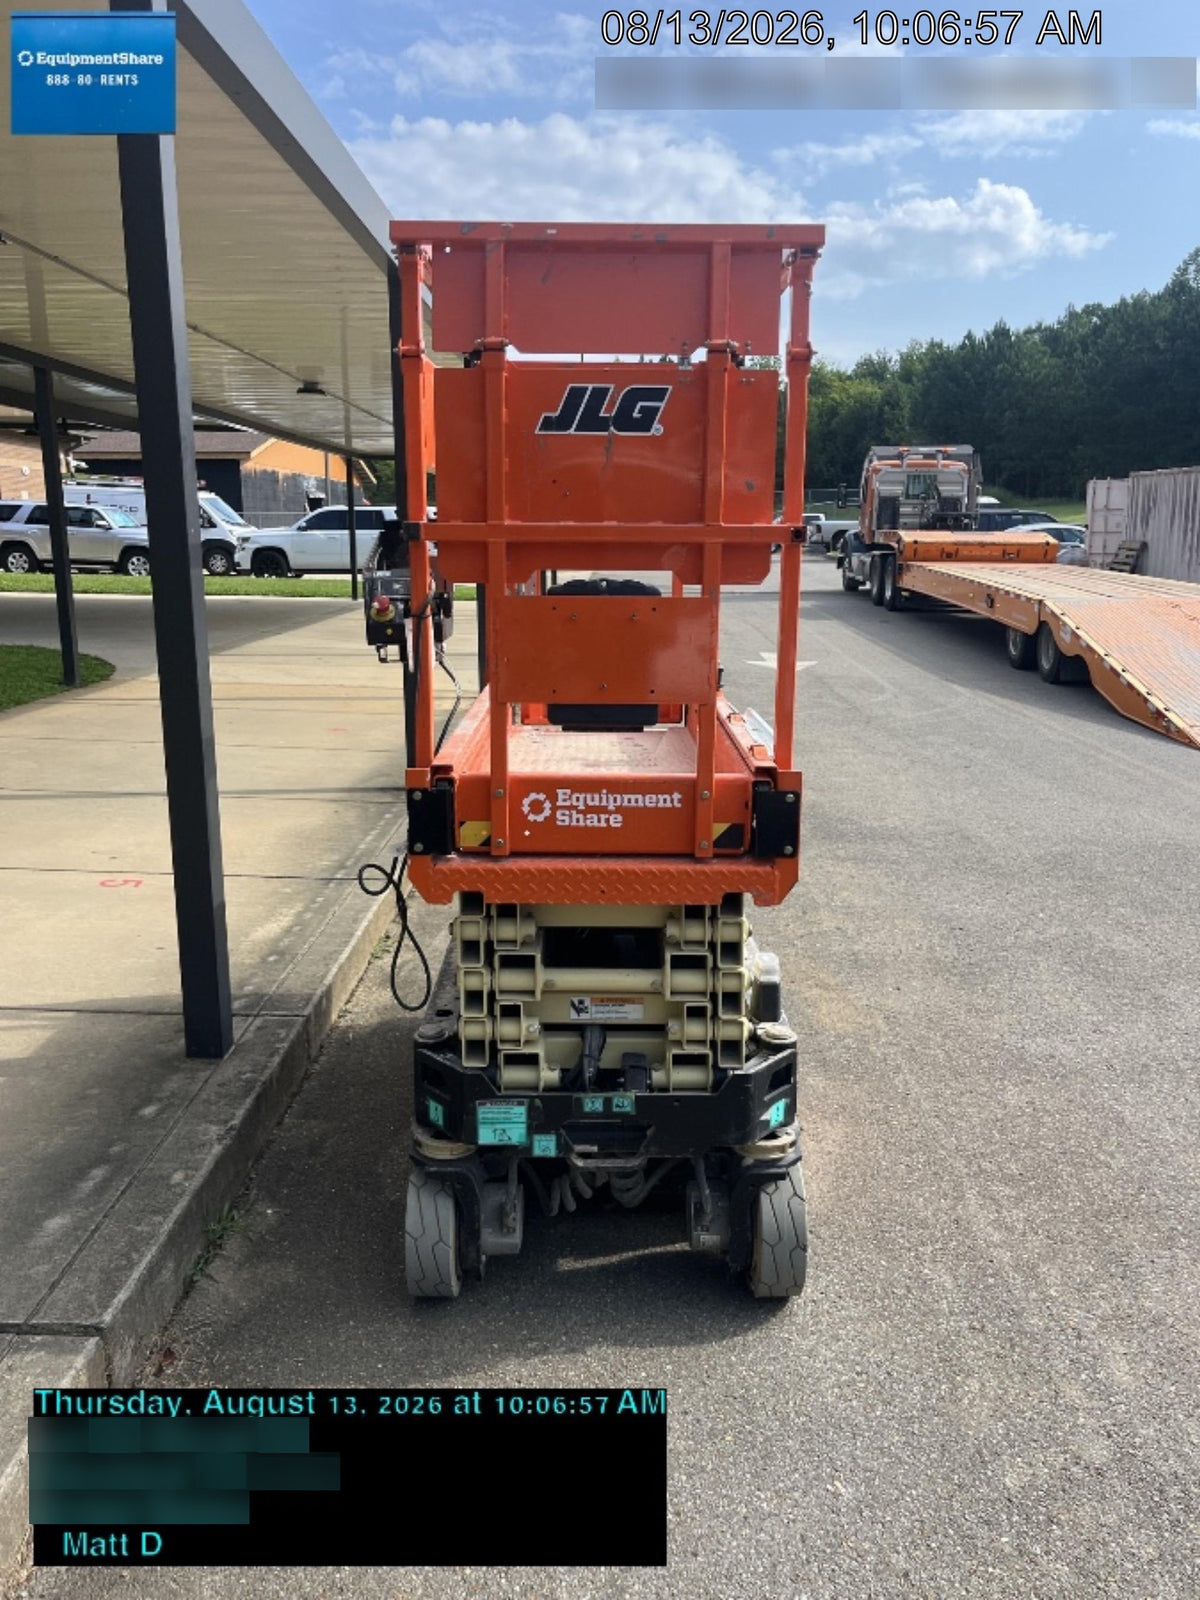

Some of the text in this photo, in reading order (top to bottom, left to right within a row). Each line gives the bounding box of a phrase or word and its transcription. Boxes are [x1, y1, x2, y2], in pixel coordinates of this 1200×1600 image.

[36, 52, 164, 67] EquipmentShare
[535, 384, 672, 436] JLG
[555, 788, 682, 811] Equipment
[555, 809, 623, 828] Share
